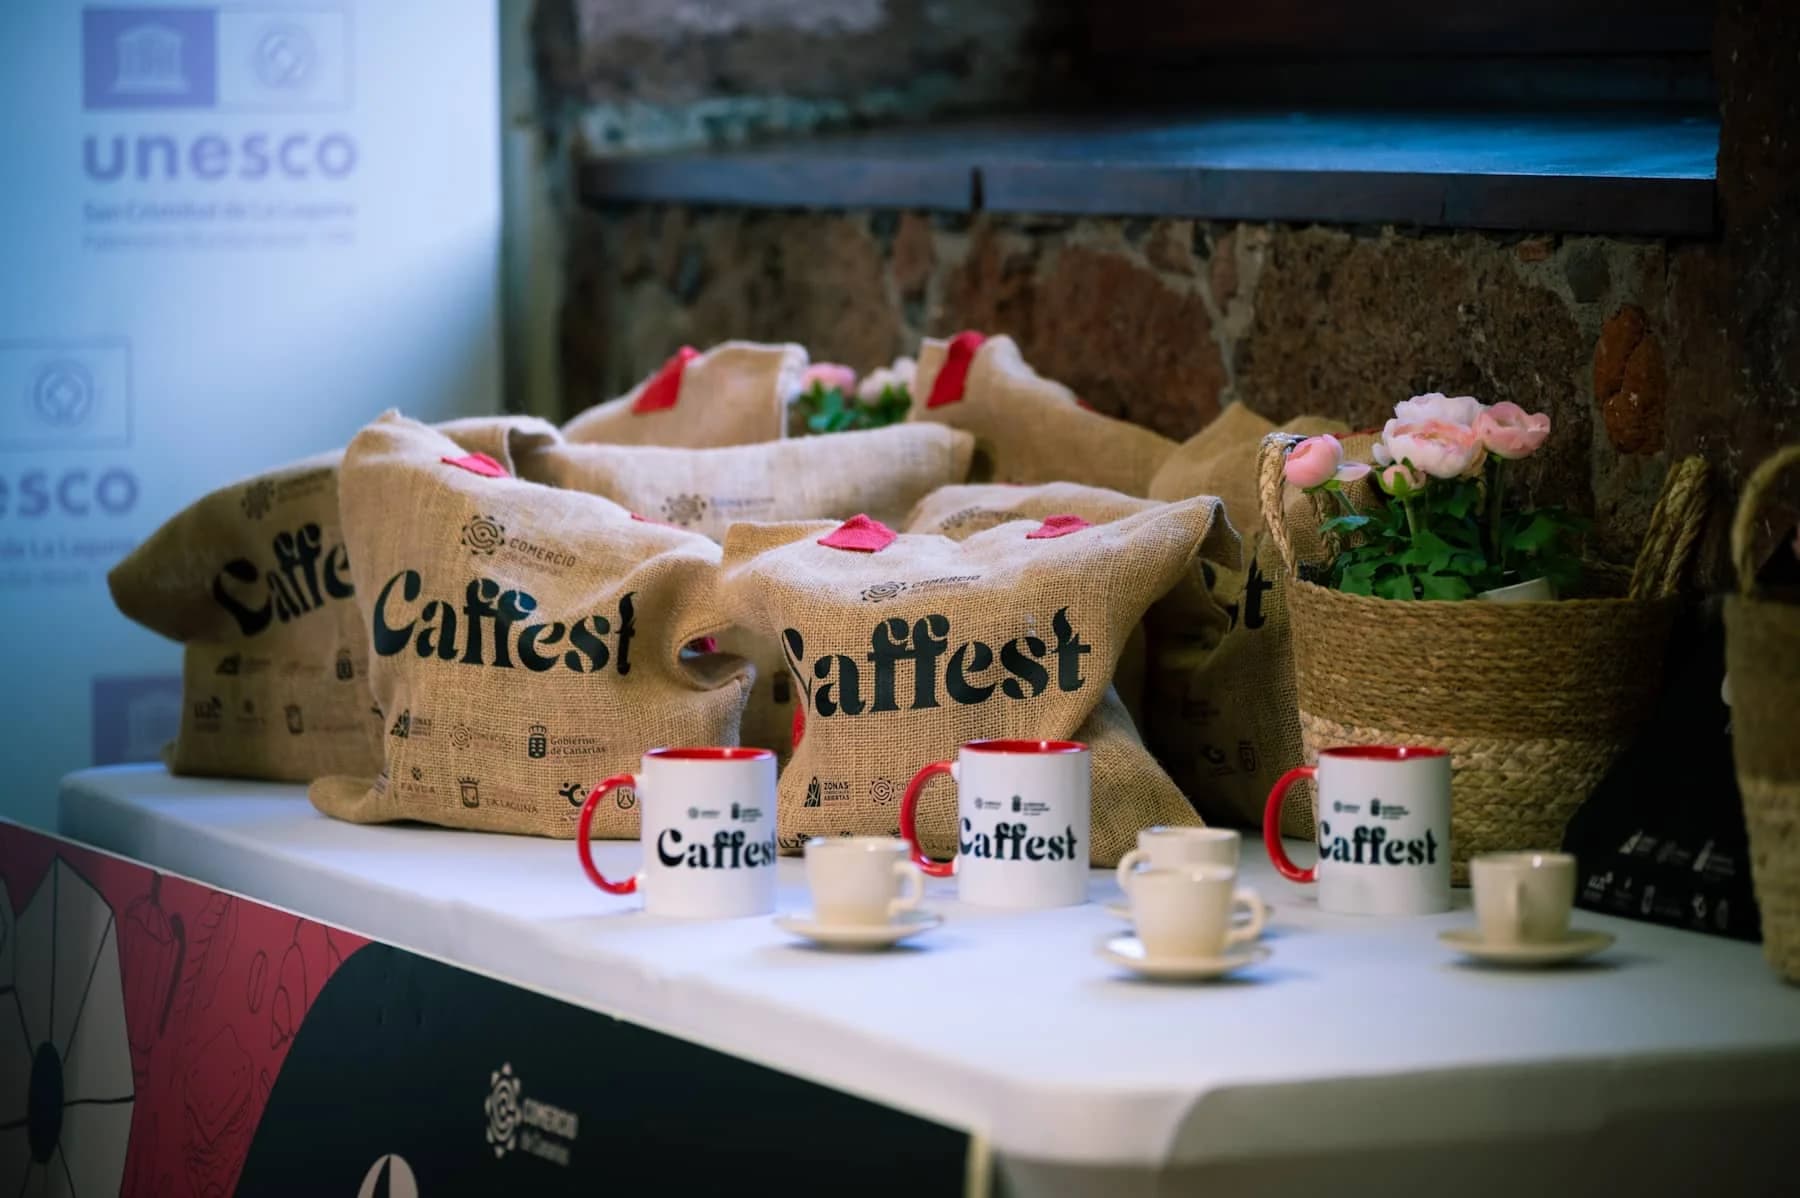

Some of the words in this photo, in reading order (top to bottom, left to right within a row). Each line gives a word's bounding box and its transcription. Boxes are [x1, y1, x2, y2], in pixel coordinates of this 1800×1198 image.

[83, 132, 358, 182] unesco
[509, 537, 577, 569] COMERCIO
[374, 569, 638, 676] Caffest
[823, 781, 849, 791] ZONAS
